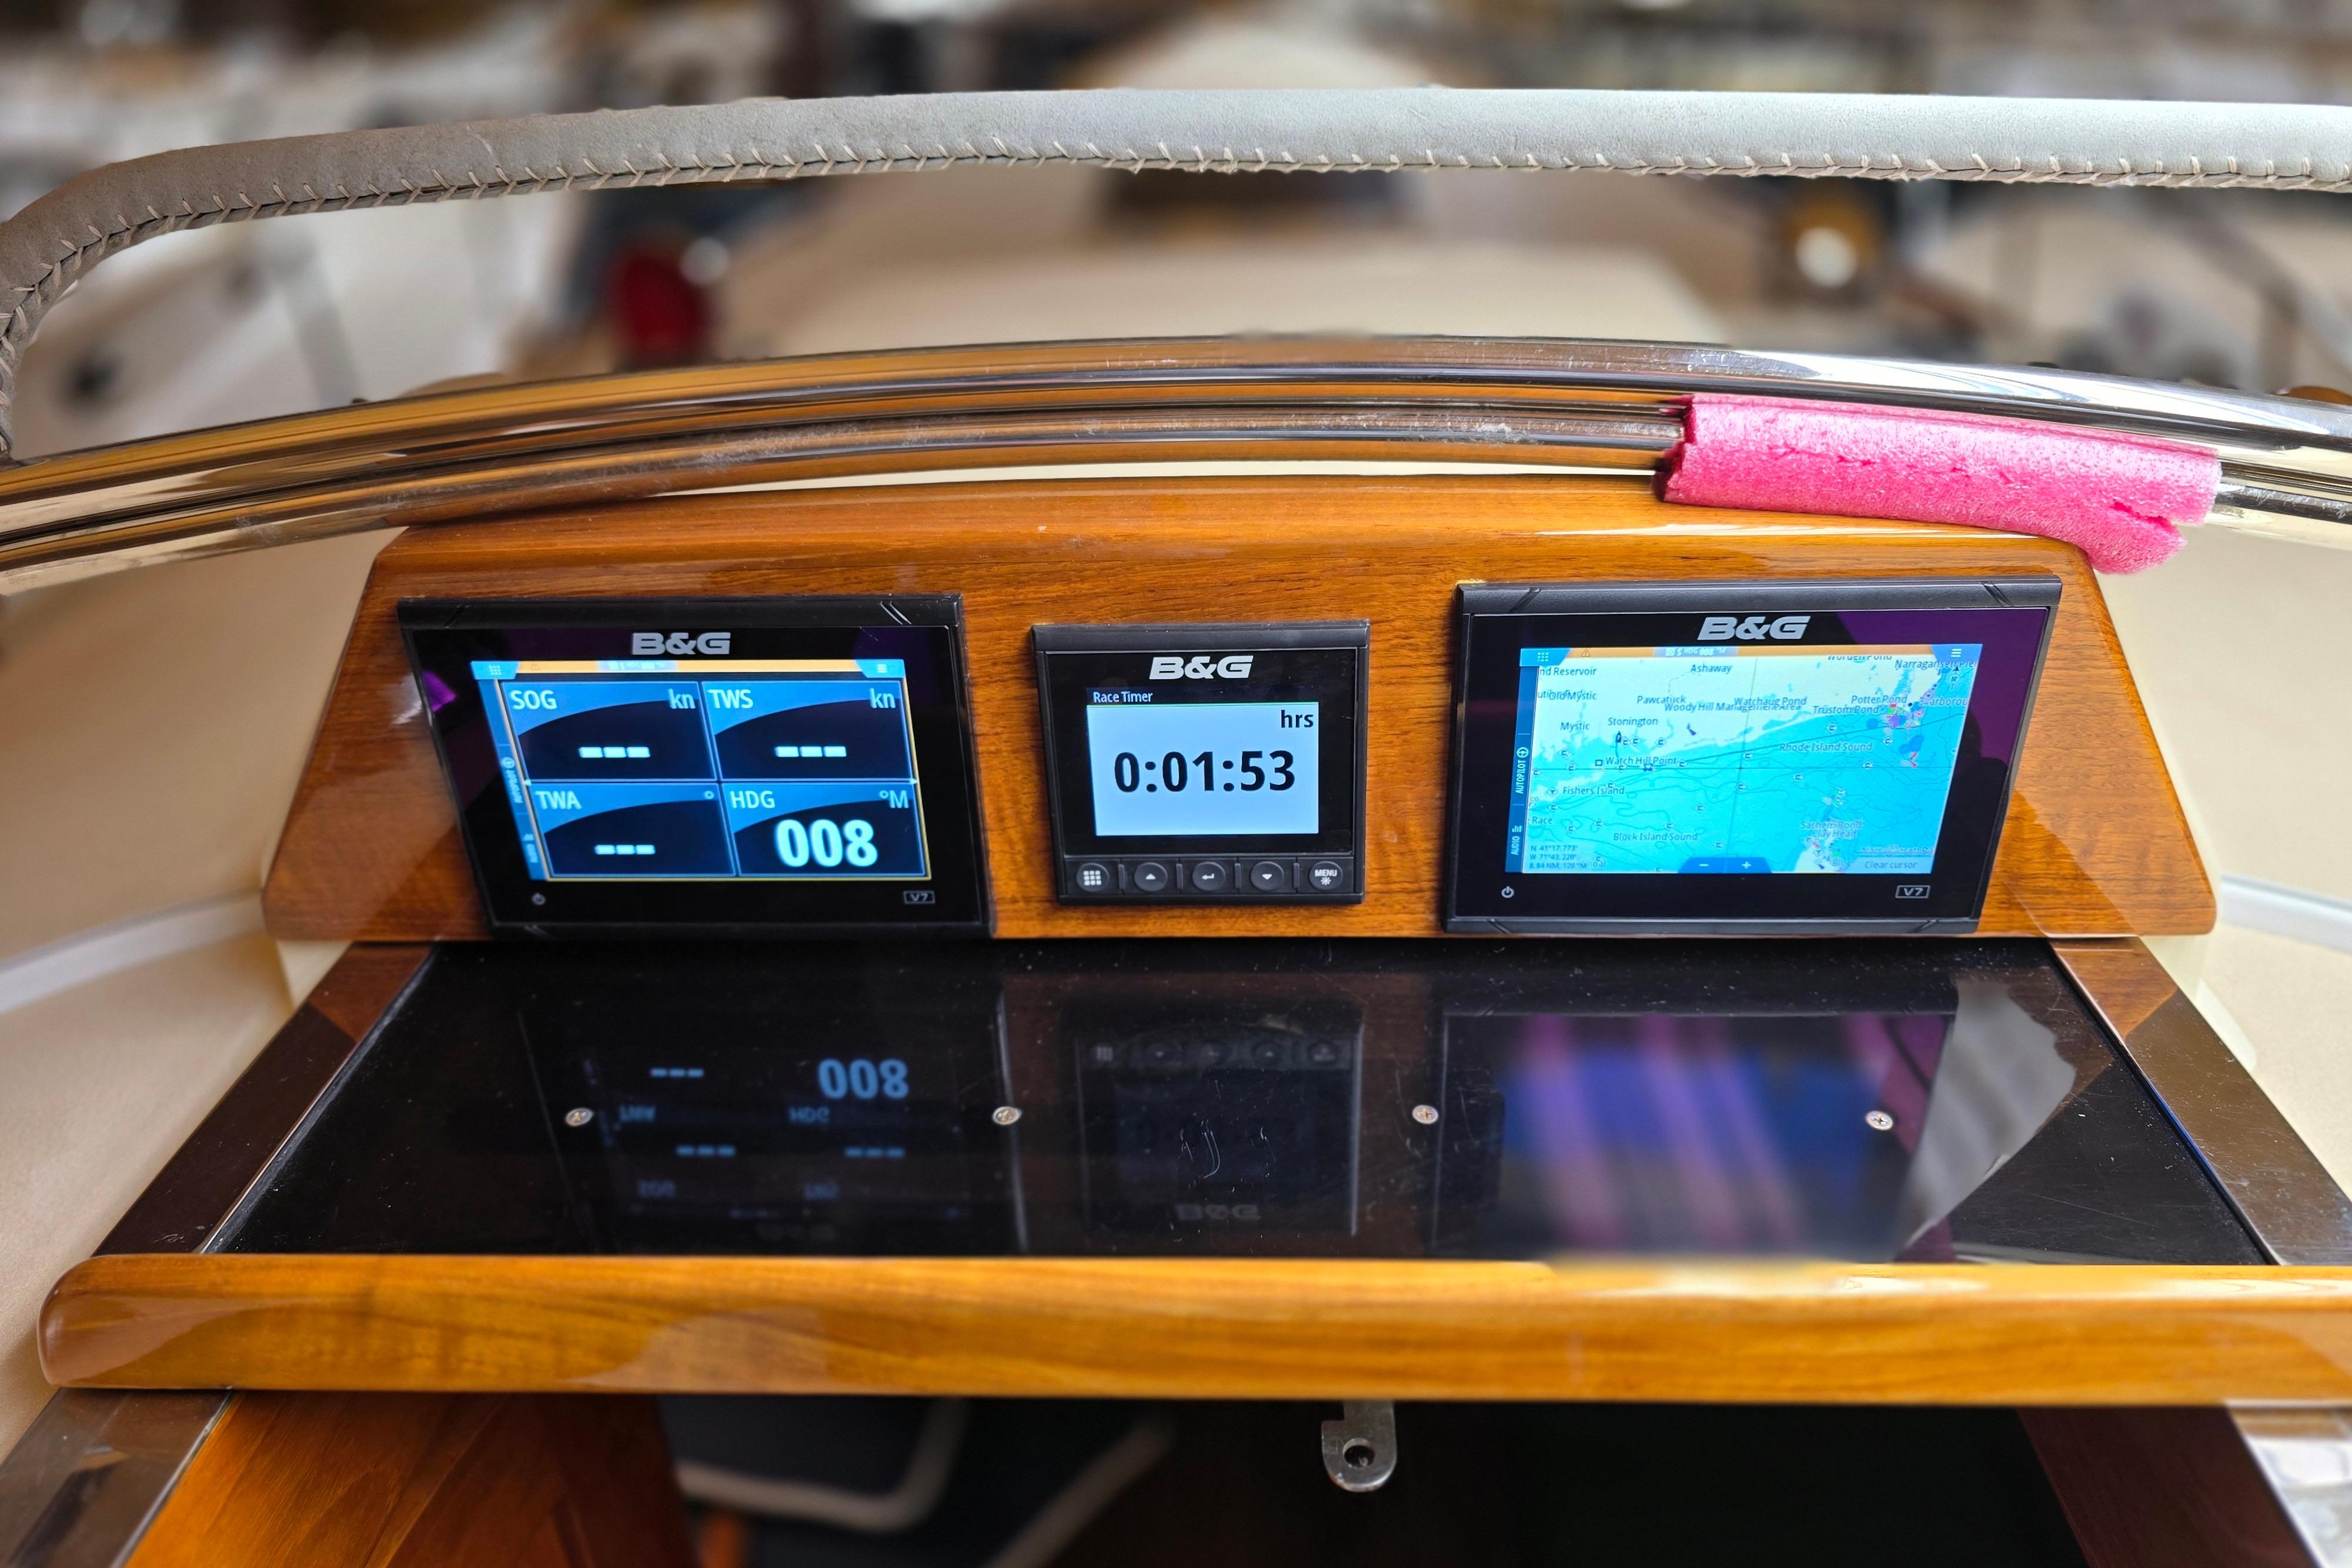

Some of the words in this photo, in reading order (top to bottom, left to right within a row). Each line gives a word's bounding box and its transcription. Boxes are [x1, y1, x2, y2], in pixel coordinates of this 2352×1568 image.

[1697, 616, 1811, 640] B&G
[632, 632, 731, 655] B&G
[1149, 655, 1254, 680] B&G
[1553, 667, 1597, 676] Reservoir
[1690, 664, 1732, 674] Ashaway
[510, 690, 557, 709] SOG
[667, 688, 696, 709] kn
[708, 689, 754, 709] TWS
[869, 688, 896, 708] kn
[1093, 690, 1120, 703] Race
[1121, 690, 1153, 703] Timer
[1567, 691, 1598, 703] Mystic
[1637, 696, 1686, 704] Pawcatuck
[1734, 697, 1780, 707] Watchaug
[1782, 696, 1807, 706] Pond
[1851, 696, 1880, 704] Potter
[1882, 695, 1907, 704] Pond
[1665, 703, 1696, 713] Woody
[1698, 703, 1713, 711] Hill
[1813, 706, 1853, 714] Trustom
[1854, 706, 1879, 714] Pond
[1280, 710, 1314, 728] hrs
[1608, 717, 1658, 728] Stonington
[1560, 721, 1589, 733] Mystic
[1779, 743, 1809, 751] Rhode
[1811, 743, 1843, 751] Island
[1843, 743, 1872, 751] Sound
[1114, 750, 1295, 793] 0:01:53
[1515, 759, 1526, 794] AUTOPILOT
[1562, 786, 1594, 795] Fishers
[1597, 786, 1625, 795] Island
[535, 790, 582, 810] TWA
[730, 790, 776, 809] HDG
[1800, 821, 1833, 829] Sachem
[1669, 833, 1698, 841] Sound
[1812, 830, 1830, 840] Clay
[1832, 829, 1856, 837] Head
[774, 819, 878, 867] 008
[1511, 835, 1520, 856] AUDIO
[910, 893, 928, 901] V7
[1903, 888, 1923, 896] V7
